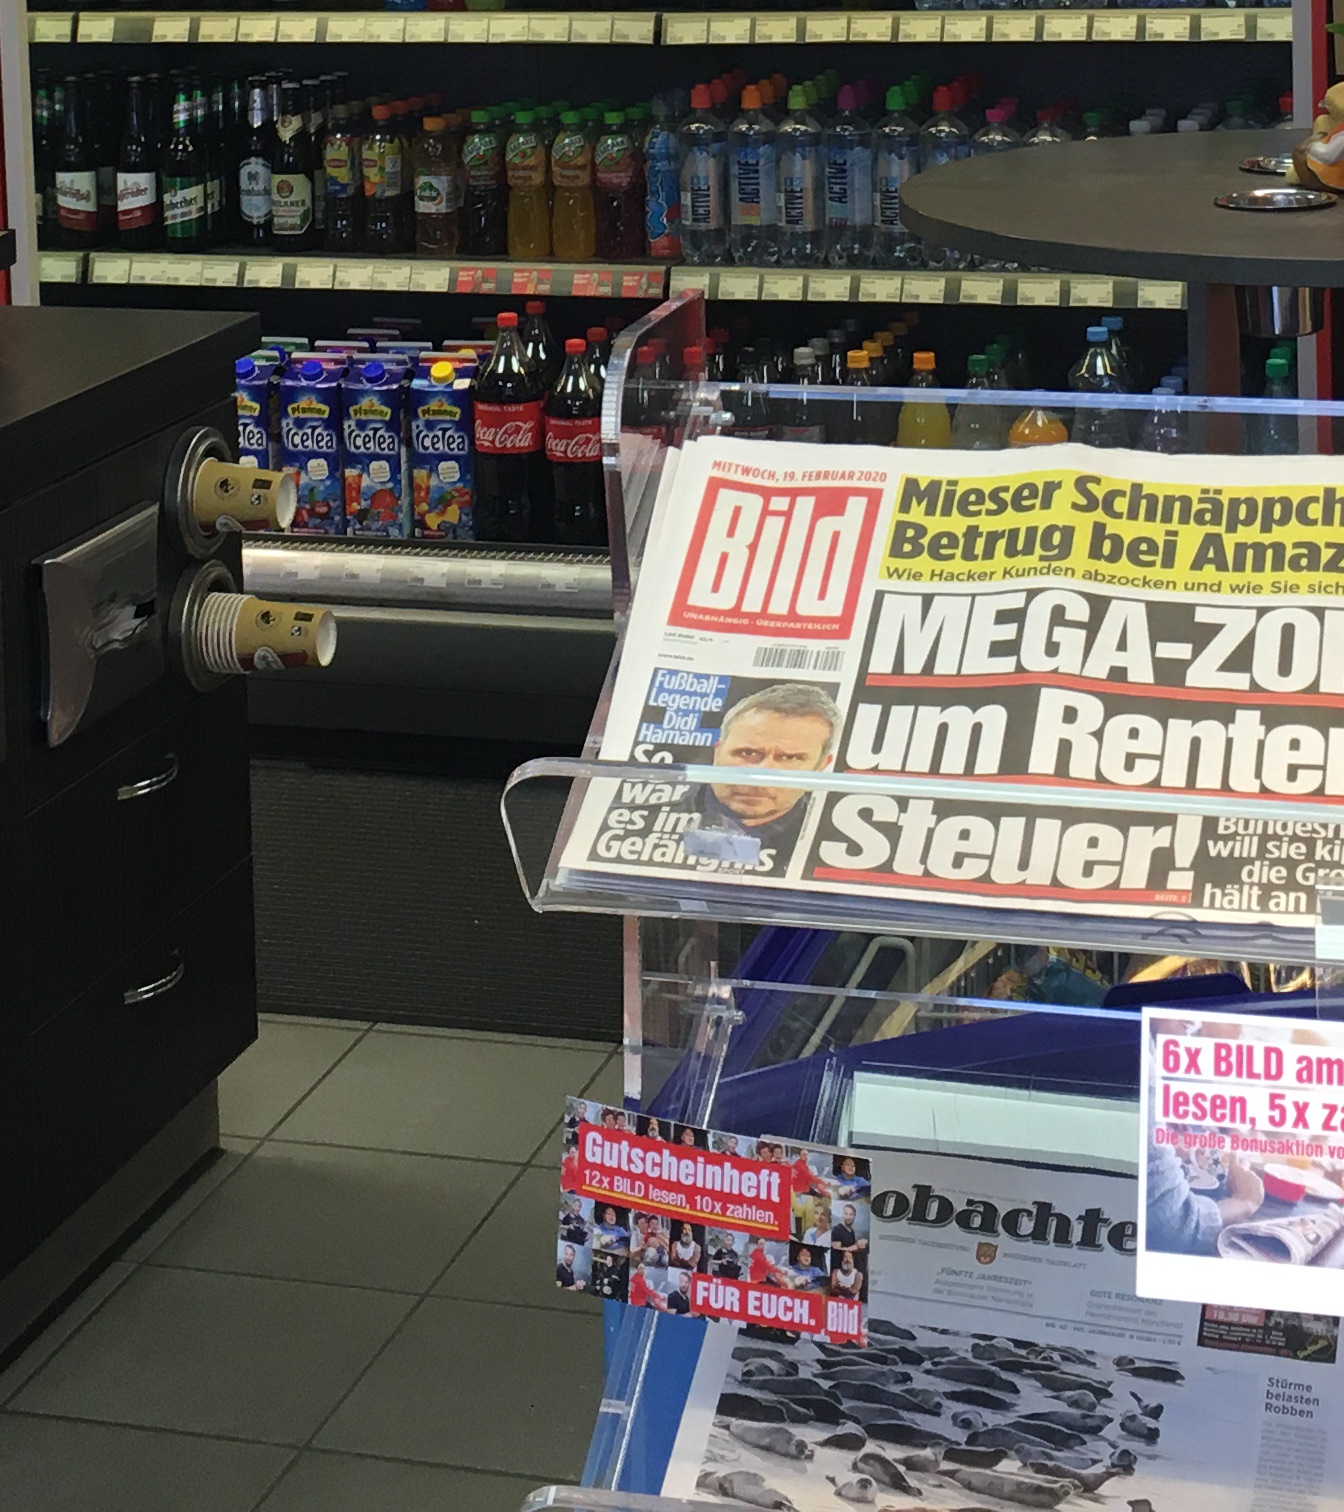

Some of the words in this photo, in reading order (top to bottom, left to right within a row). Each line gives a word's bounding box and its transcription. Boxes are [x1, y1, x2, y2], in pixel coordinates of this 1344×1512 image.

[711, 460, 779, 483] MITTWOCH,
[781, 470, 798, 483] 19.
[801, 470, 856, 483] FEBRUAR
[857, 471, 888, 484] 2020
[897, 474, 1062, 518] Mieser
[685, 488, 868, 617] Bild
[887, 520, 1077, 564] Betrug
[1088, 523, 1176, 569] bei
[885, 565, 924, 582] Wie
[928, 567, 997, 584] Hacker
[1002, 564, 1077, 580] Kunden
[1081, 569, 1178, 591] abzocken
[1183, 577, 1223, 595] und
[1227, 579, 1264, 596] wie
[1269, 580, 1301, 597] Sie
[655, 669, 726, 694] Fußball-
[648, 690, 722, 712] Legende
[637, 723, 712, 746] Hamann
[662, 710, 698, 731] Didi
[845, 699, 1007, 776] um
[620, 780, 690, 805] war
[607, 806, 650, 831] es
[658, 806, 702, 833] im
[818, 792, 1202, 890] Steuer!
[1207, 836, 1260, 860] will
[1265, 838, 1308, 861] sie
[1240, 862, 1290, 885] die
[1202, 886, 1261, 911] hält
[1267, 890, 1308, 914] an
[1161, 1039, 1202, 1076] 6x
[1213, 1043, 1284, 1081] BILD
[1295, 1055, 1344, 1086] am
[1161, 1083, 1256, 1129] lesen,
[1268, 1093, 1311, 1129] 5x
[1155, 1128, 1179, 1146] Die
[1183, 1130, 1226, 1150] große
[1230, 1134, 1323, 1158] Bonusaktion
[584, 1131, 780, 1203] Gutscheinheft
[584, 1169, 610, 1189] 12x
[613, 1175, 645, 1198] BILD
[648, 1182, 690, 1209] lesen,
[694, 1195, 722, 1214] 10x
[726, 1201, 779, 1226] zahlen.
[696, 1277, 740, 1312] FÜR
[747, 1290, 816, 1326] EUCH.
[827, 1301, 859, 1336] Bild
[1265, 1389, 1320, 1406] belasten
[1267, 1377, 1313, 1392] Stürme
[1264, 1401, 1314, 1419] Robben
